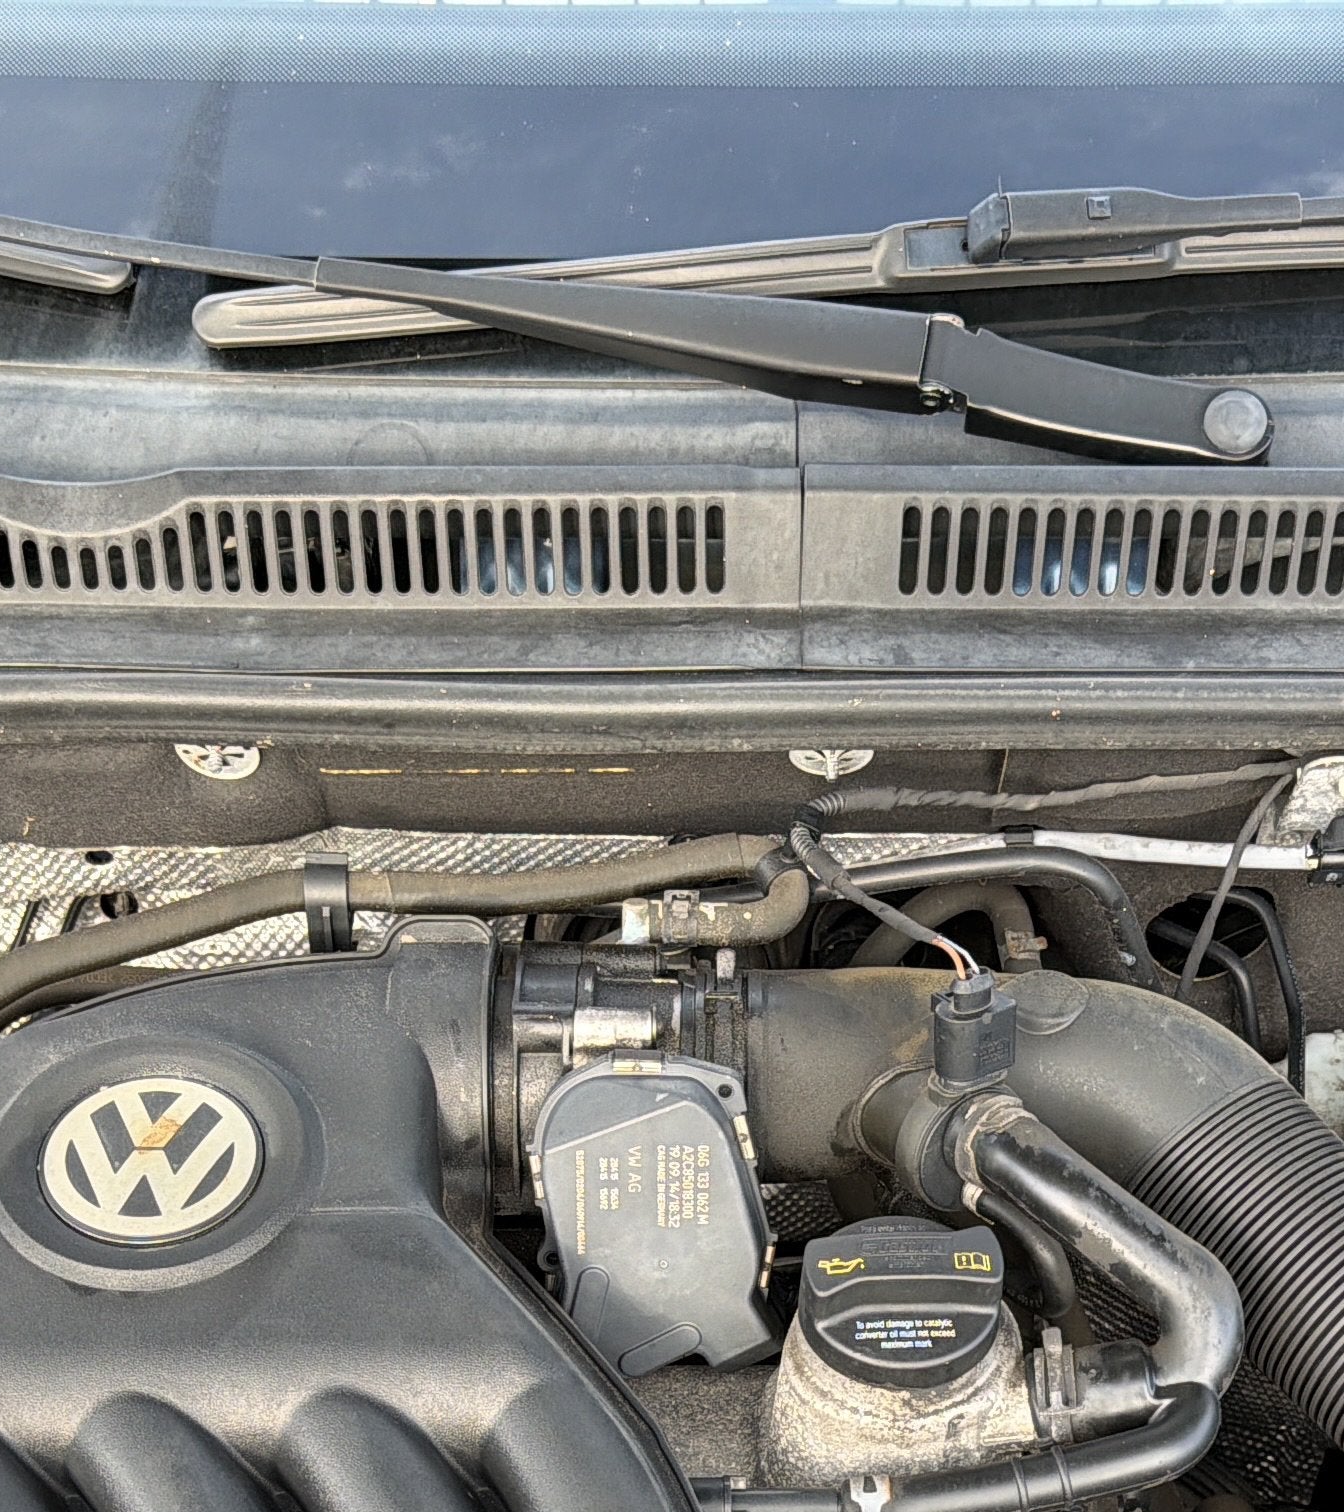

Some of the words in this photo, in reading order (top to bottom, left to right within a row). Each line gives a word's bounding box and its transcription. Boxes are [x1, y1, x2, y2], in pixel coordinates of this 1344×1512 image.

[42, 1076, 258, 1240] VW
[628, 1145, 642, 1167] VW
[697, 1145, 710, 1167] 06G
[628, 1173, 642, 1193] AG
[697, 1171, 710, 1189] 133
[856, 1321, 864, 1329] To
[865, 1320, 885, 1329] avoid
[886, 1319, 914, 1329] damage
[915, 1320, 922, 1328] to
[923, 1319, 953, 1329] catalytic
[855, 1330, 888, 1340] converter
[917, 1330, 929, 1338] not
[930, 1329, 956, 1338] exceed
